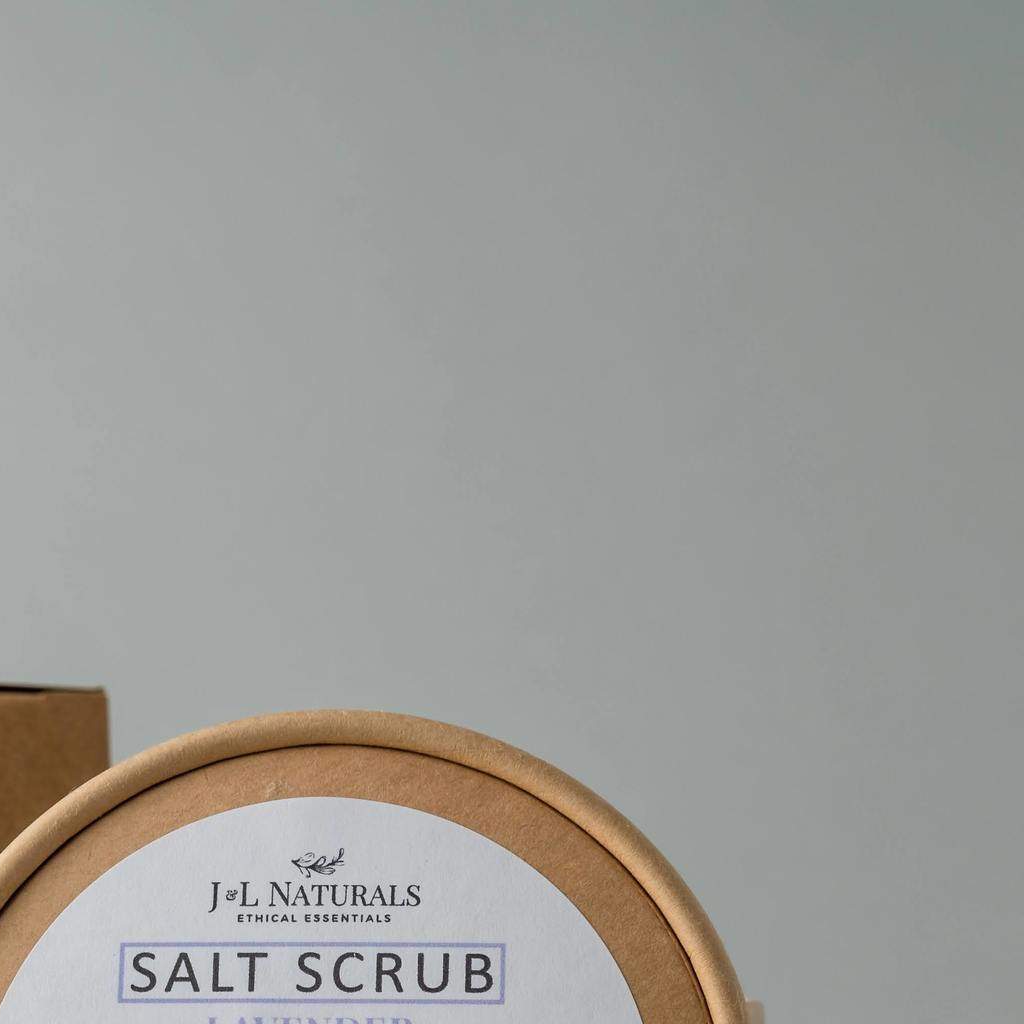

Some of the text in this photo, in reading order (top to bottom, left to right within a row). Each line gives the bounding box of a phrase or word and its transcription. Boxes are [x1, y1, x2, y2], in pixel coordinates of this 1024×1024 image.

[208, 882, 421, 915] J&L NATURALS
[238, 914, 390, 923] ETHICAL ESSENTIALS
[131, 952, 493, 993] SALT SCRUB
